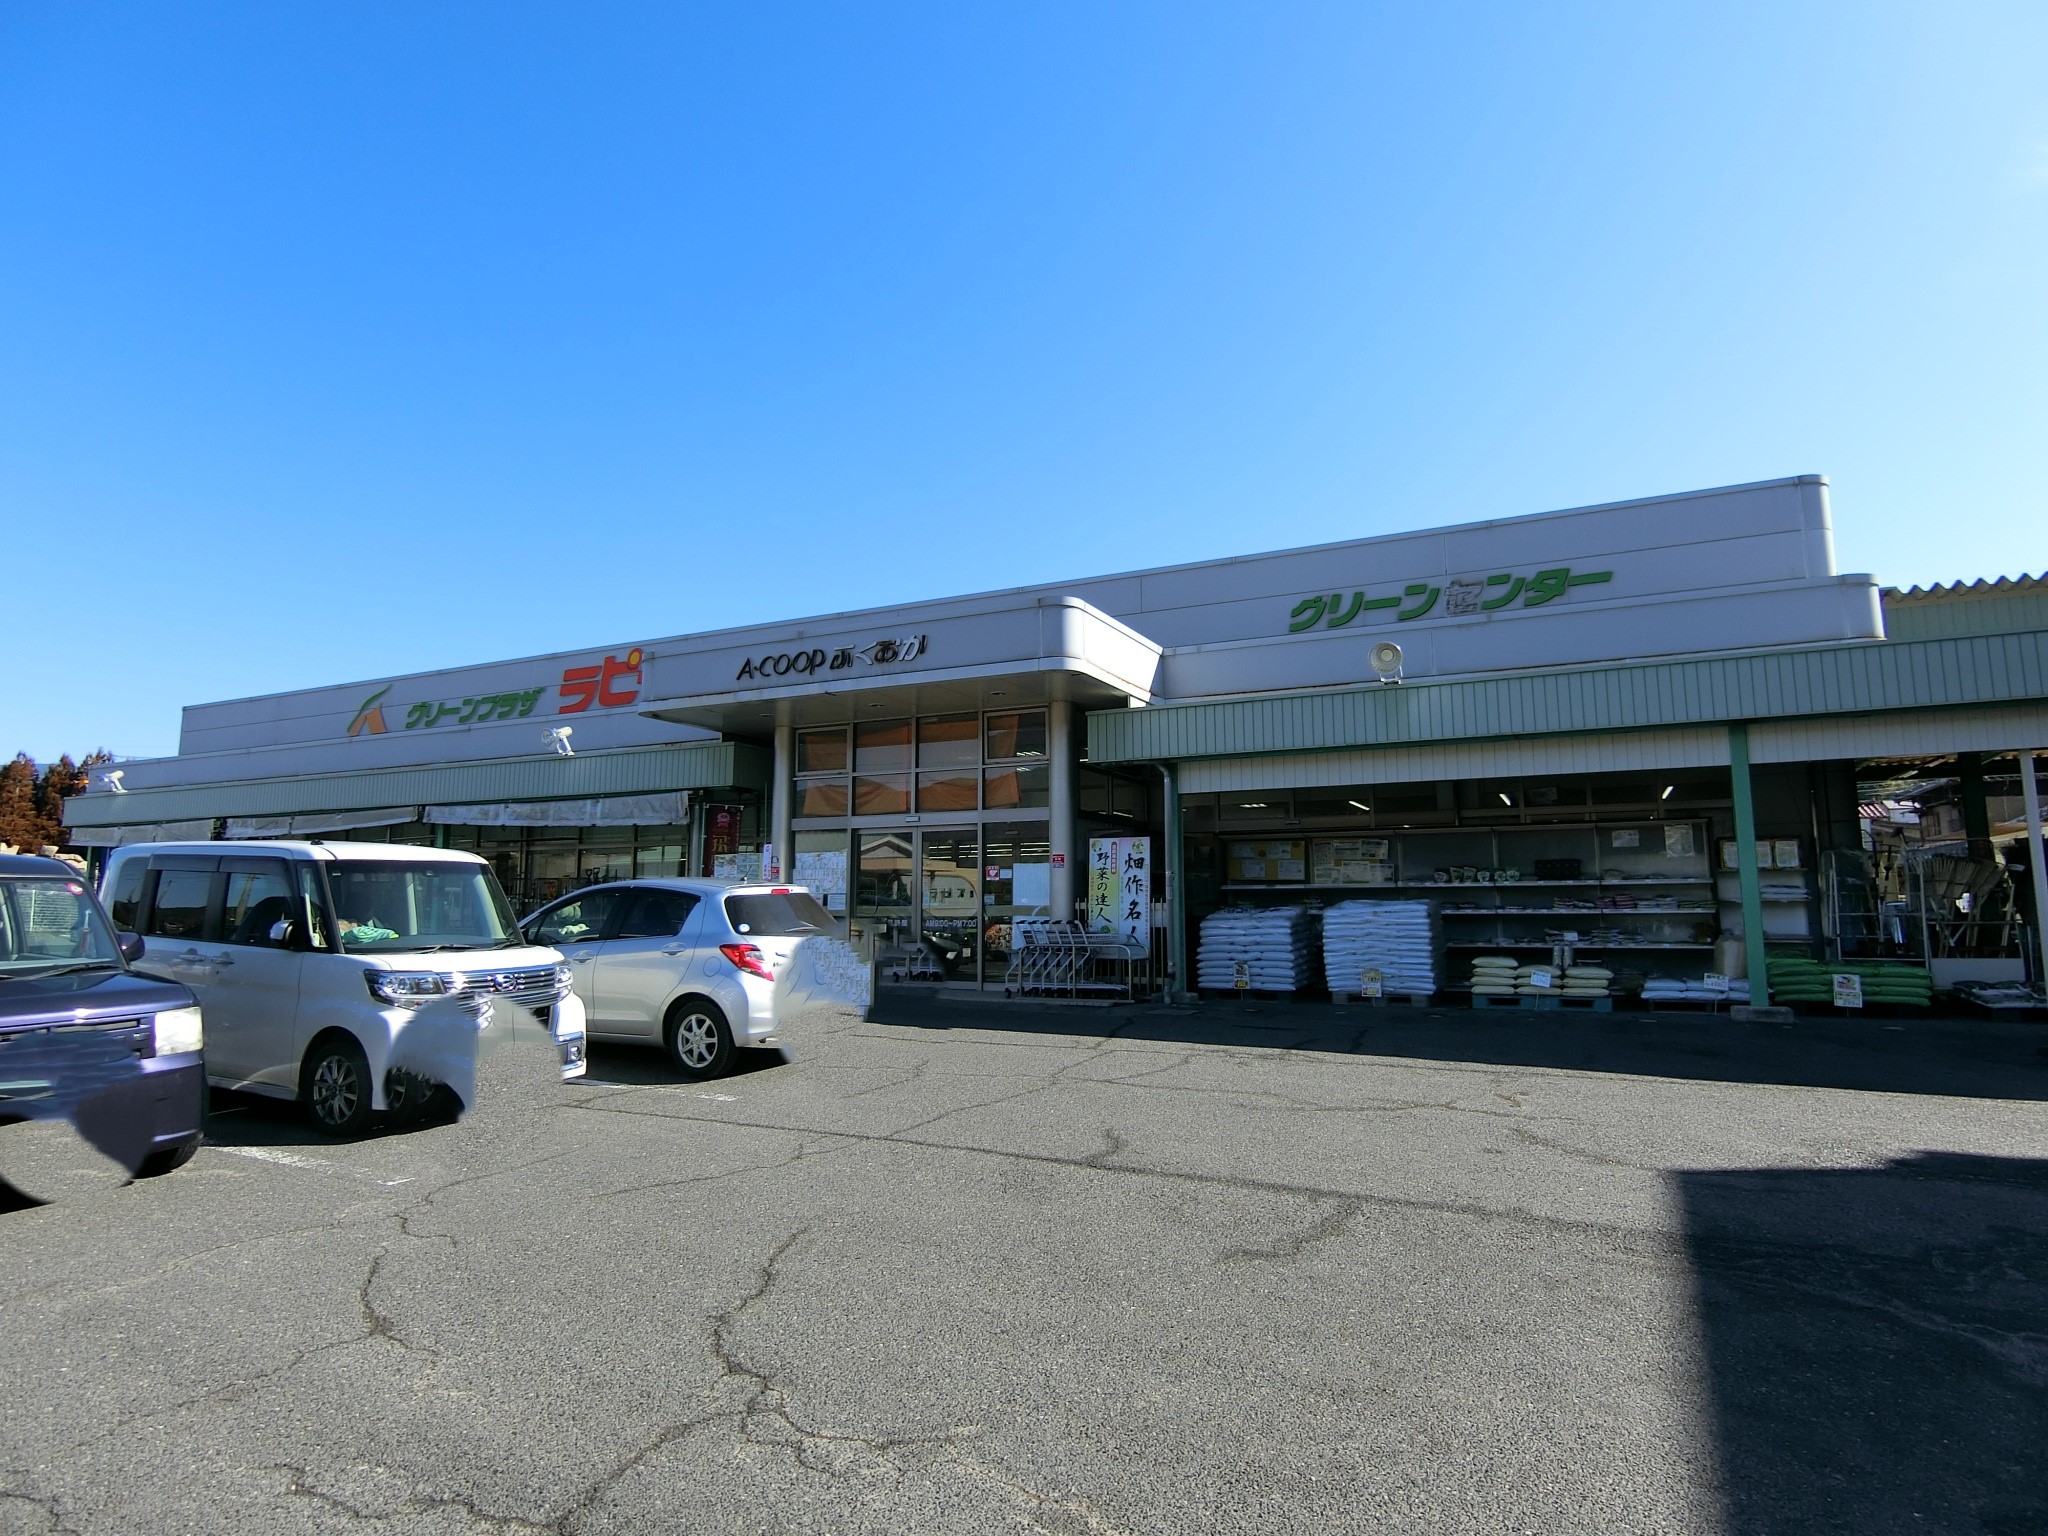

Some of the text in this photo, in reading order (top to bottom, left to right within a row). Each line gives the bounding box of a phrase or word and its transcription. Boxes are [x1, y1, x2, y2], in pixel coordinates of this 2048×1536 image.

[1289, 568, 1613, 632] グリーンセンター
[405, 686, 546, 729] グリーンプラザ
[558, 647, 643, 714] ラピ
[1094, 849, 1113, 924] 野菜の達人
[1124, 853, 1146, 947] 畑作名人
